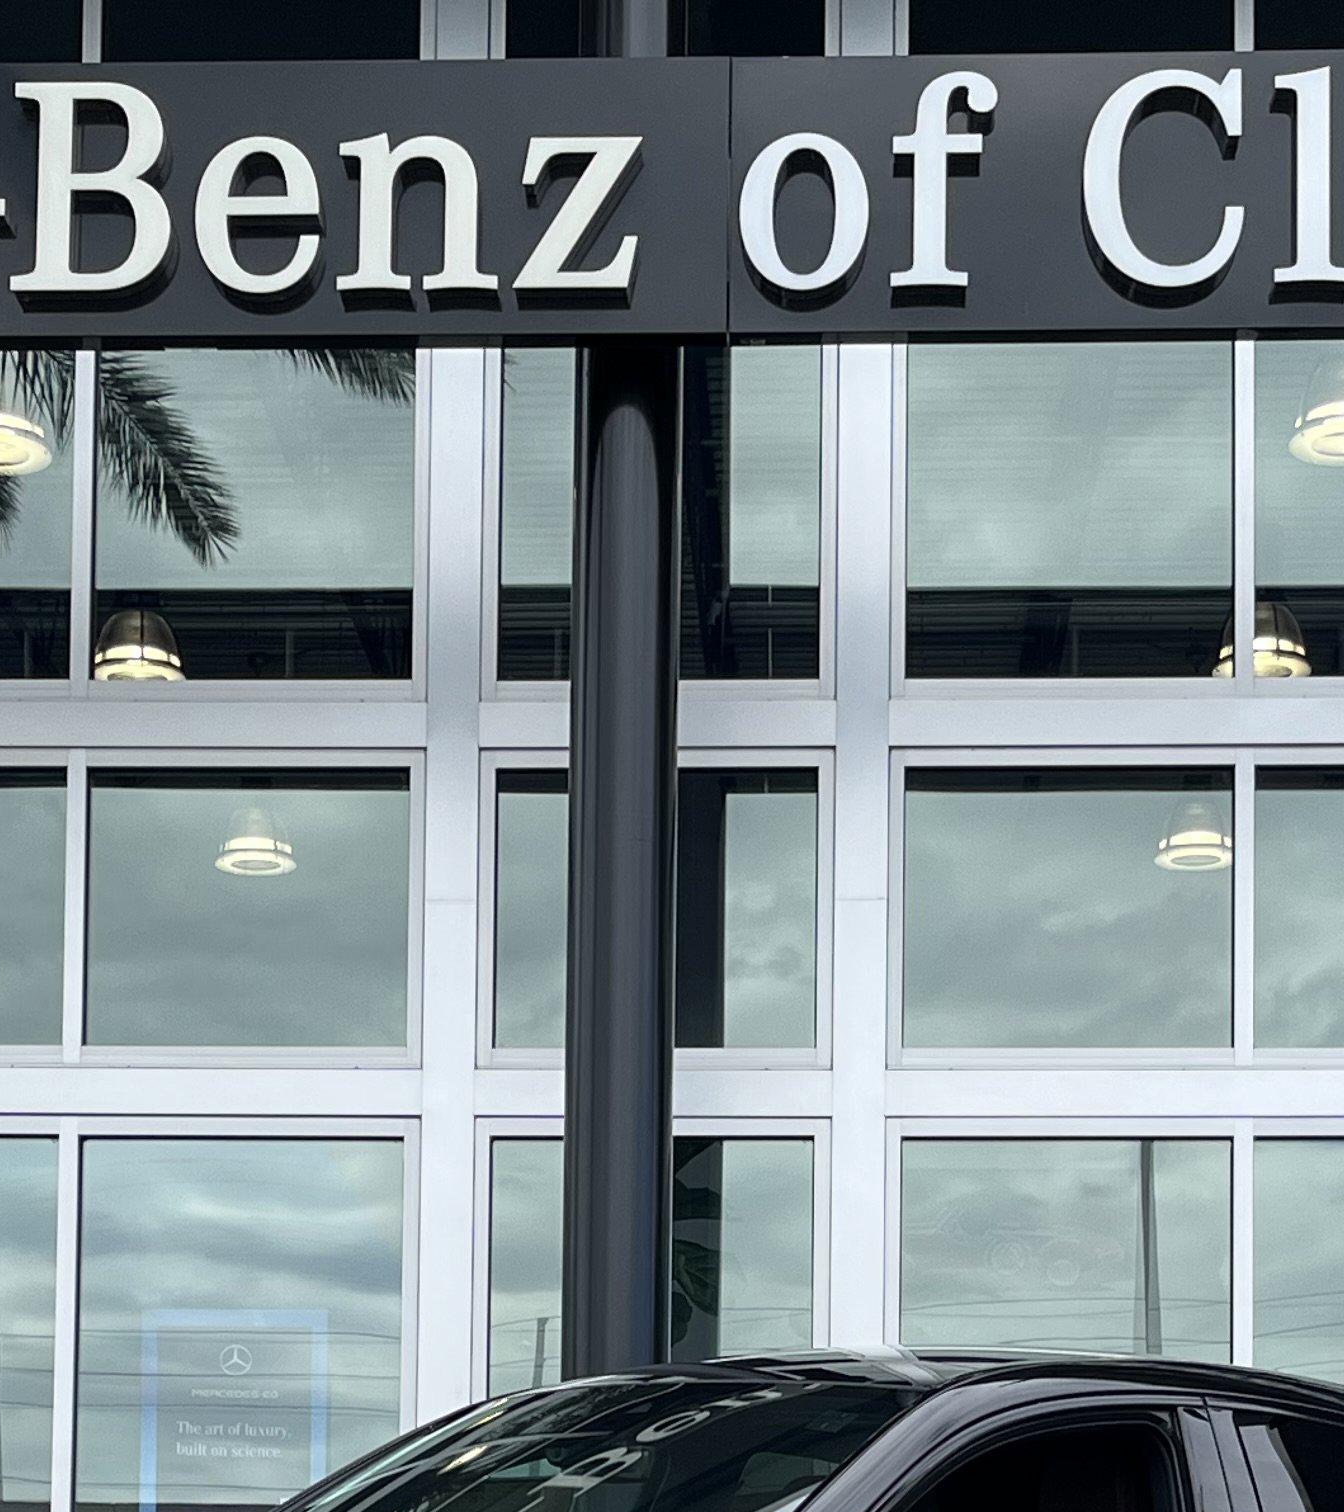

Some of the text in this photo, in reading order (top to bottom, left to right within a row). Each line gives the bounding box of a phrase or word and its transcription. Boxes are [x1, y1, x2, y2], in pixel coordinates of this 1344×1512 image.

[738, 70, 1000, 290] of
[176, 1420, 202, 1435] The
[204, 1423, 225, 1436] art
[227, 1422, 243, 1436] of
[176, 1441, 208, 1457] built
[210, 1446, 228, 1457] on
